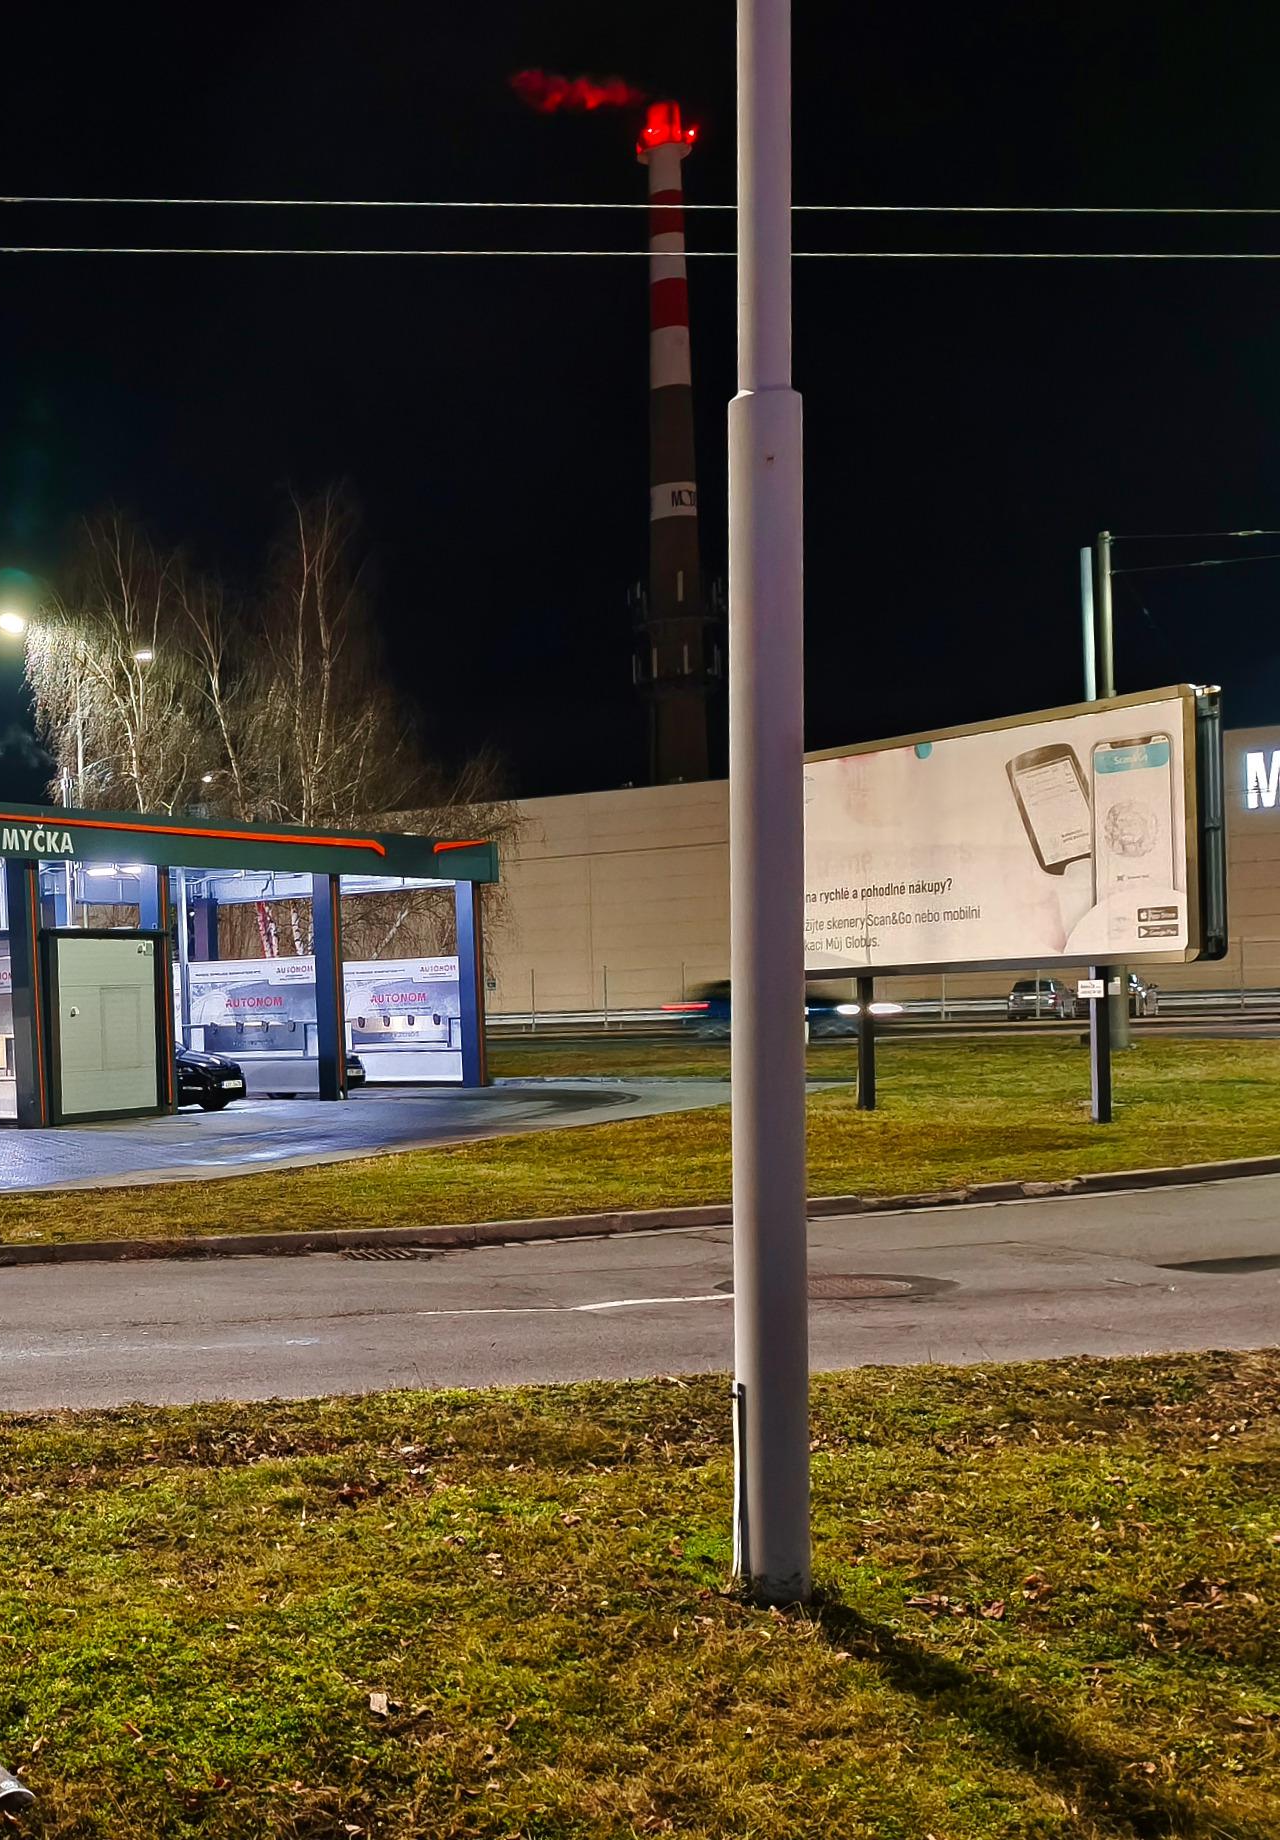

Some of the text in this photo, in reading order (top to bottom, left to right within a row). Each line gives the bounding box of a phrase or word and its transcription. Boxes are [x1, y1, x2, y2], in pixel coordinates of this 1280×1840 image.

[1246, 750, 1280, 809] M
[2, 824, 74, 854] MYČKA
[820, 888, 850, 904] rychlé
[852, 889, 858, 900] a
[861, 882, 906, 900] pohodlné
[908, 878, 953, 895] nákupy?
[826, 916, 865, 931] skenery
[866, 911, 912, 927] Scan&Go
[914, 909, 940, 924] nebo
[225, 995, 283, 1009] AUTONOM
[370, 992, 426, 1004] AUTONOM
